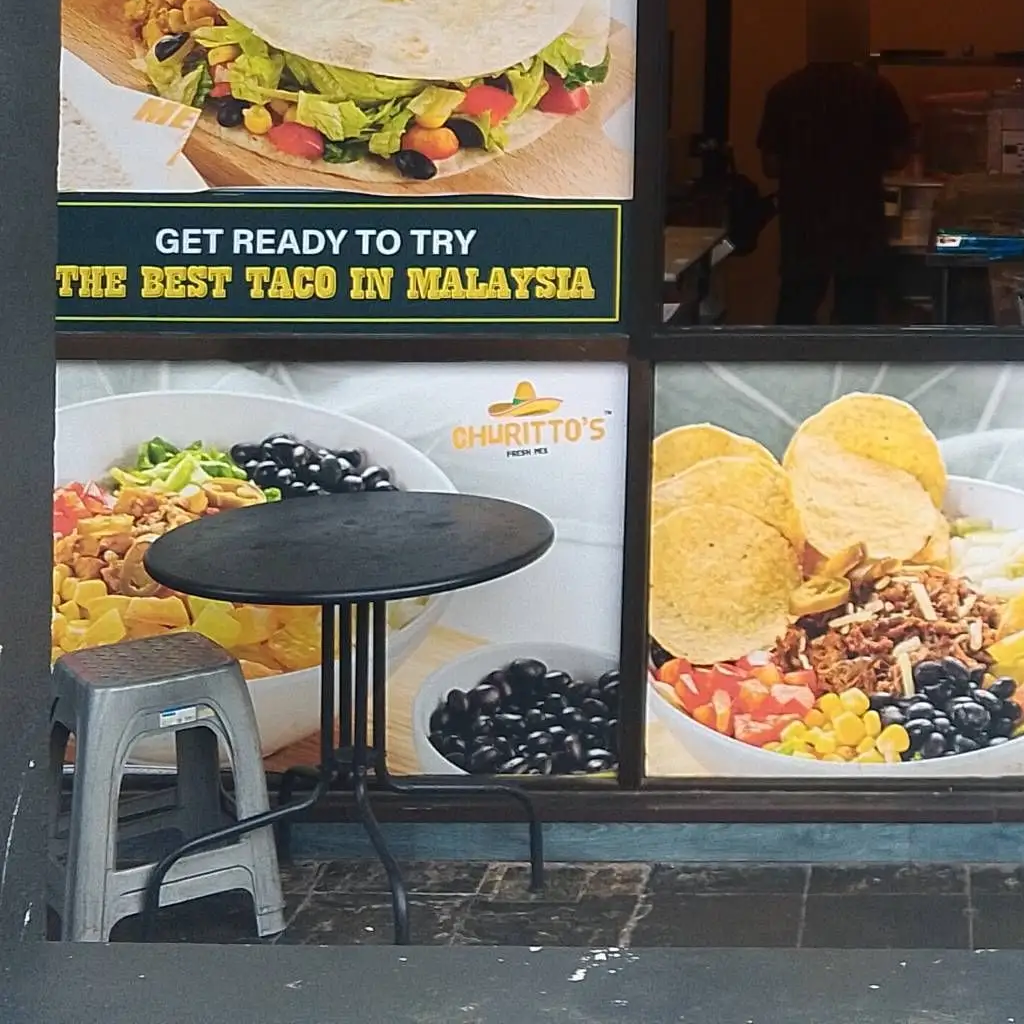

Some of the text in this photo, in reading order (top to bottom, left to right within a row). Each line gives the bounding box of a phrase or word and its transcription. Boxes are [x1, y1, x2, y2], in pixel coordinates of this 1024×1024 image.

[155, 228, 477, 256] GET READY TO TRY
[55, 264, 597, 301] THE BEST TACO IN MALAYSIA
[452, 416, 606, 450] CHURITTO'S
